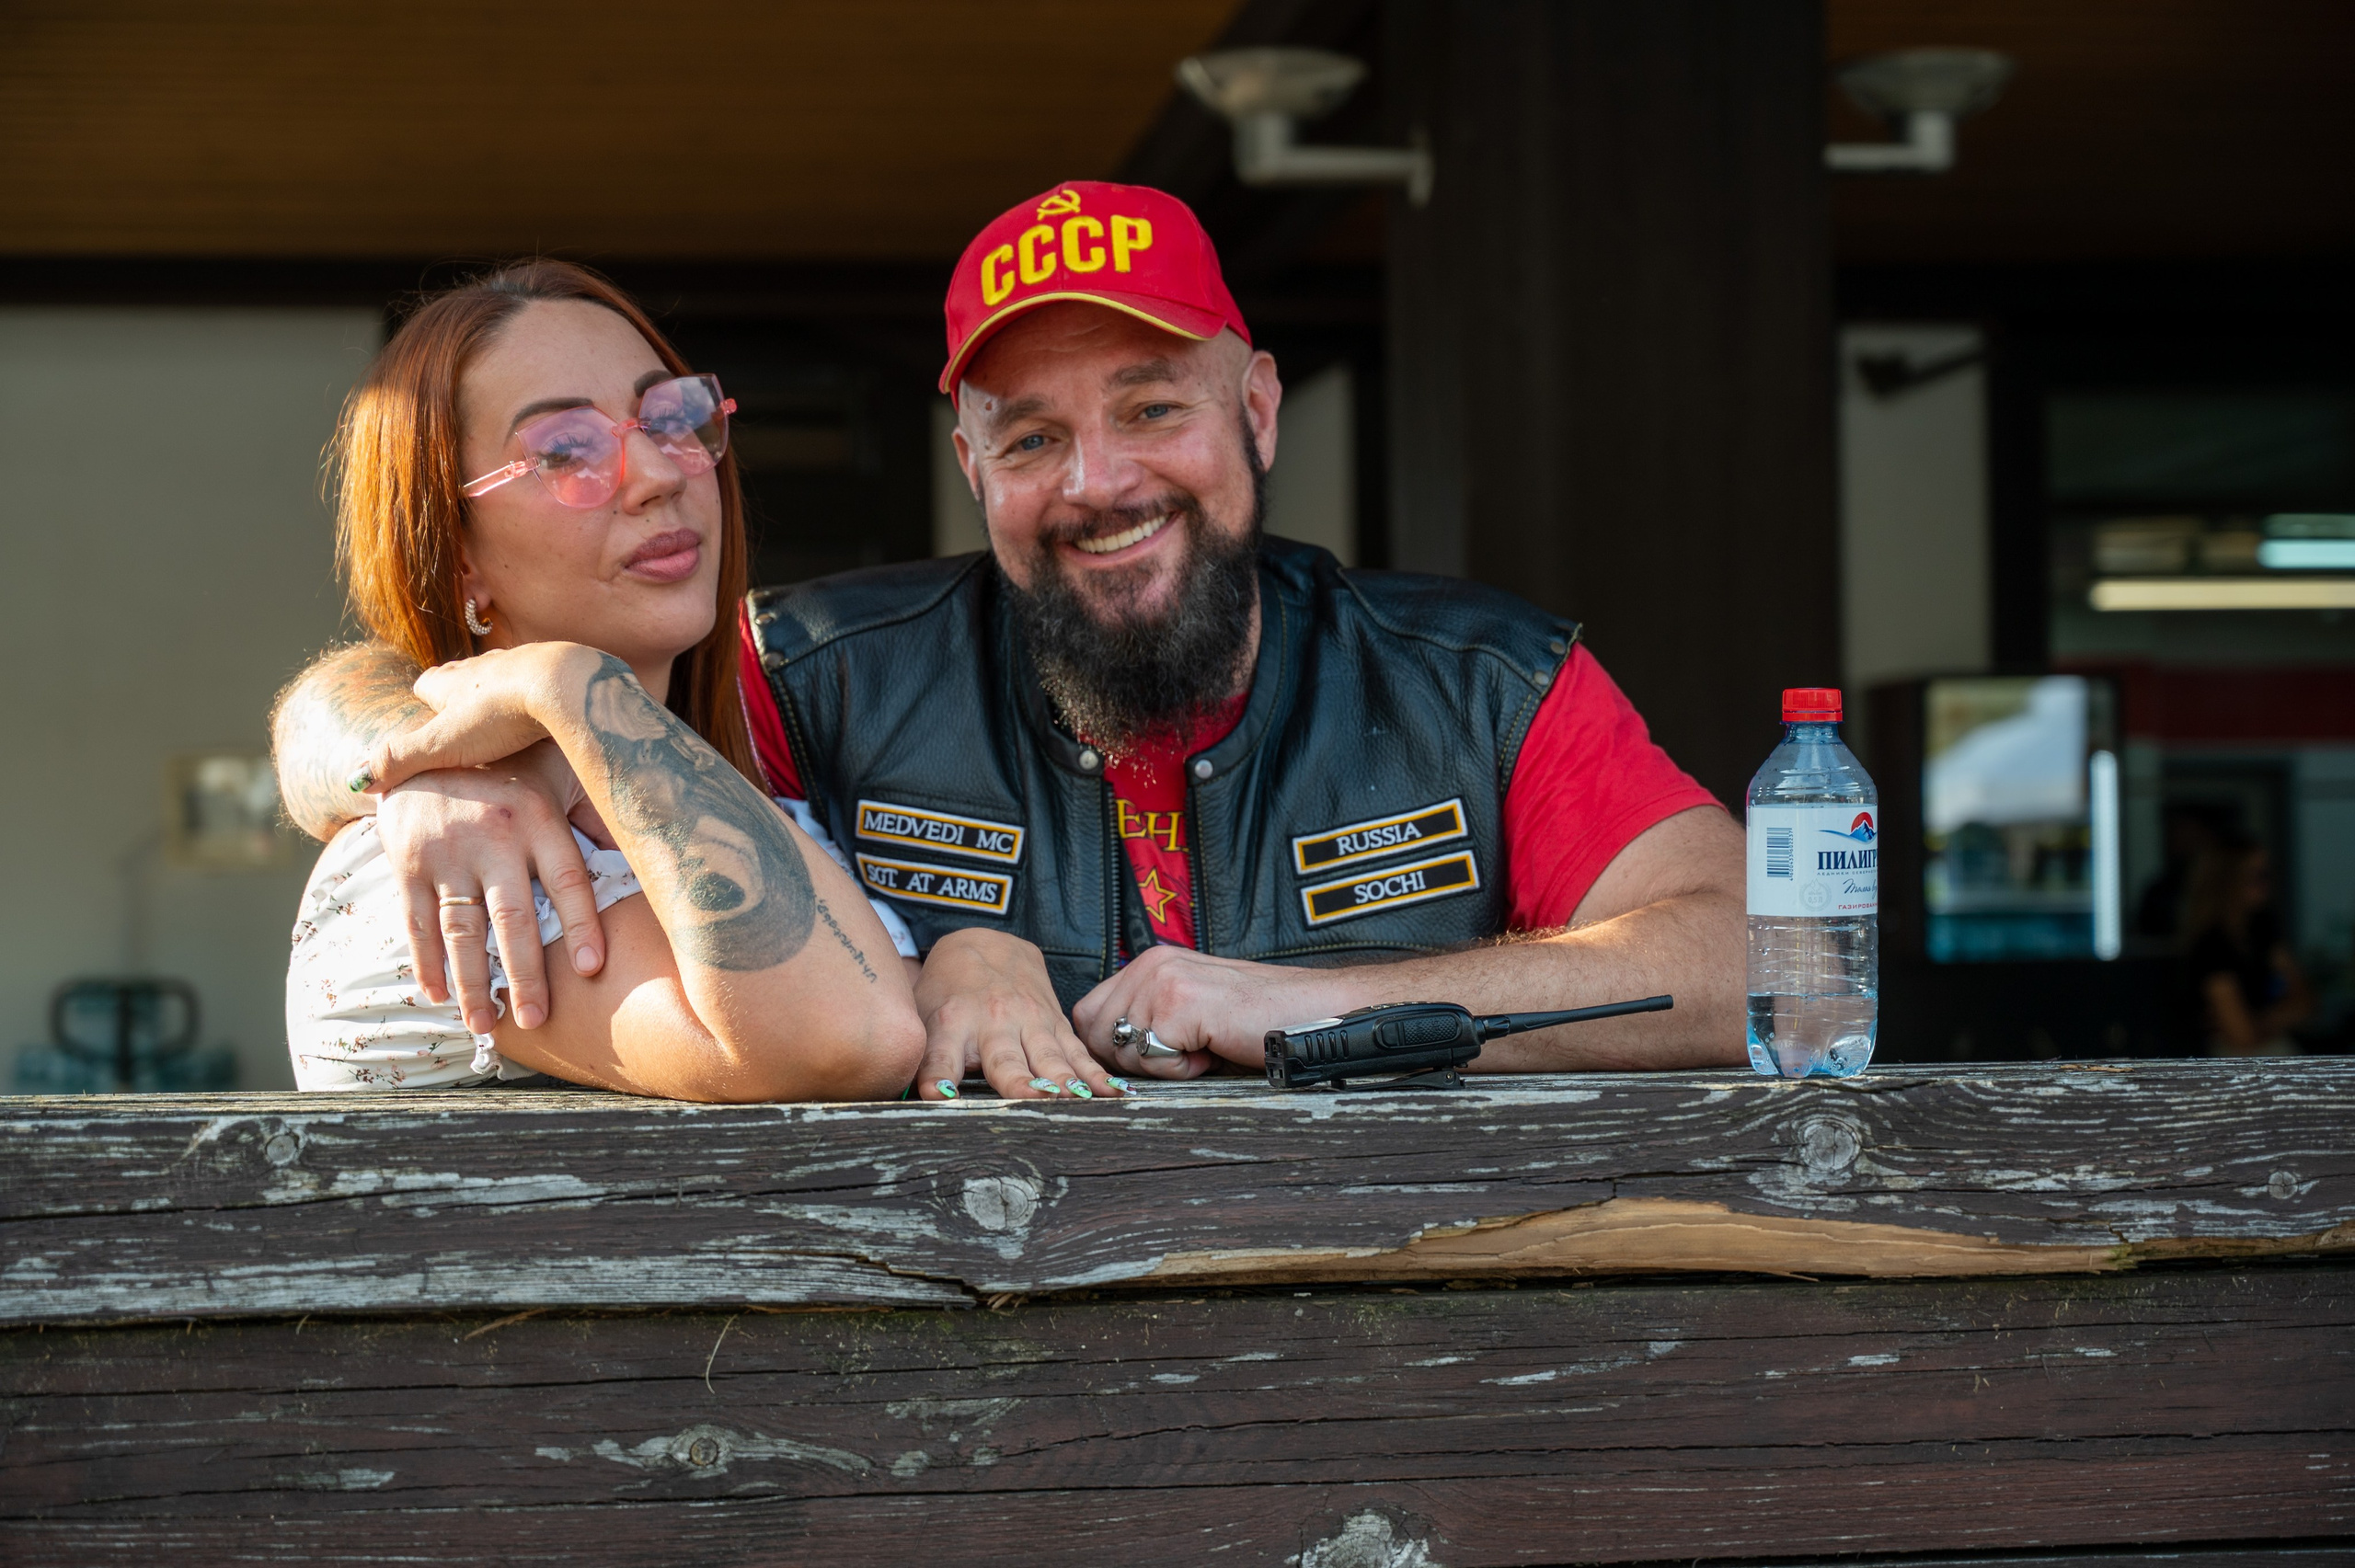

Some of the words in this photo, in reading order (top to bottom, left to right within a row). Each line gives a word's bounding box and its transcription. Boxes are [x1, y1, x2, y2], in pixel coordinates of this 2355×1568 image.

[981, 214, 1153, 307] СССР
[864, 810, 964, 845] MEDVEDI
[975, 830, 1014, 853] MC
[1336, 822, 1422, 856] RUSSIA
[1817, 849, 1878, 870] ПИЛИГР
[867, 864, 898, 888] SGT
[906, 873, 935, 893] AT
[936, 877, 998, 903] ARMS
[1354, 871, 1427, 904] SOCHI
